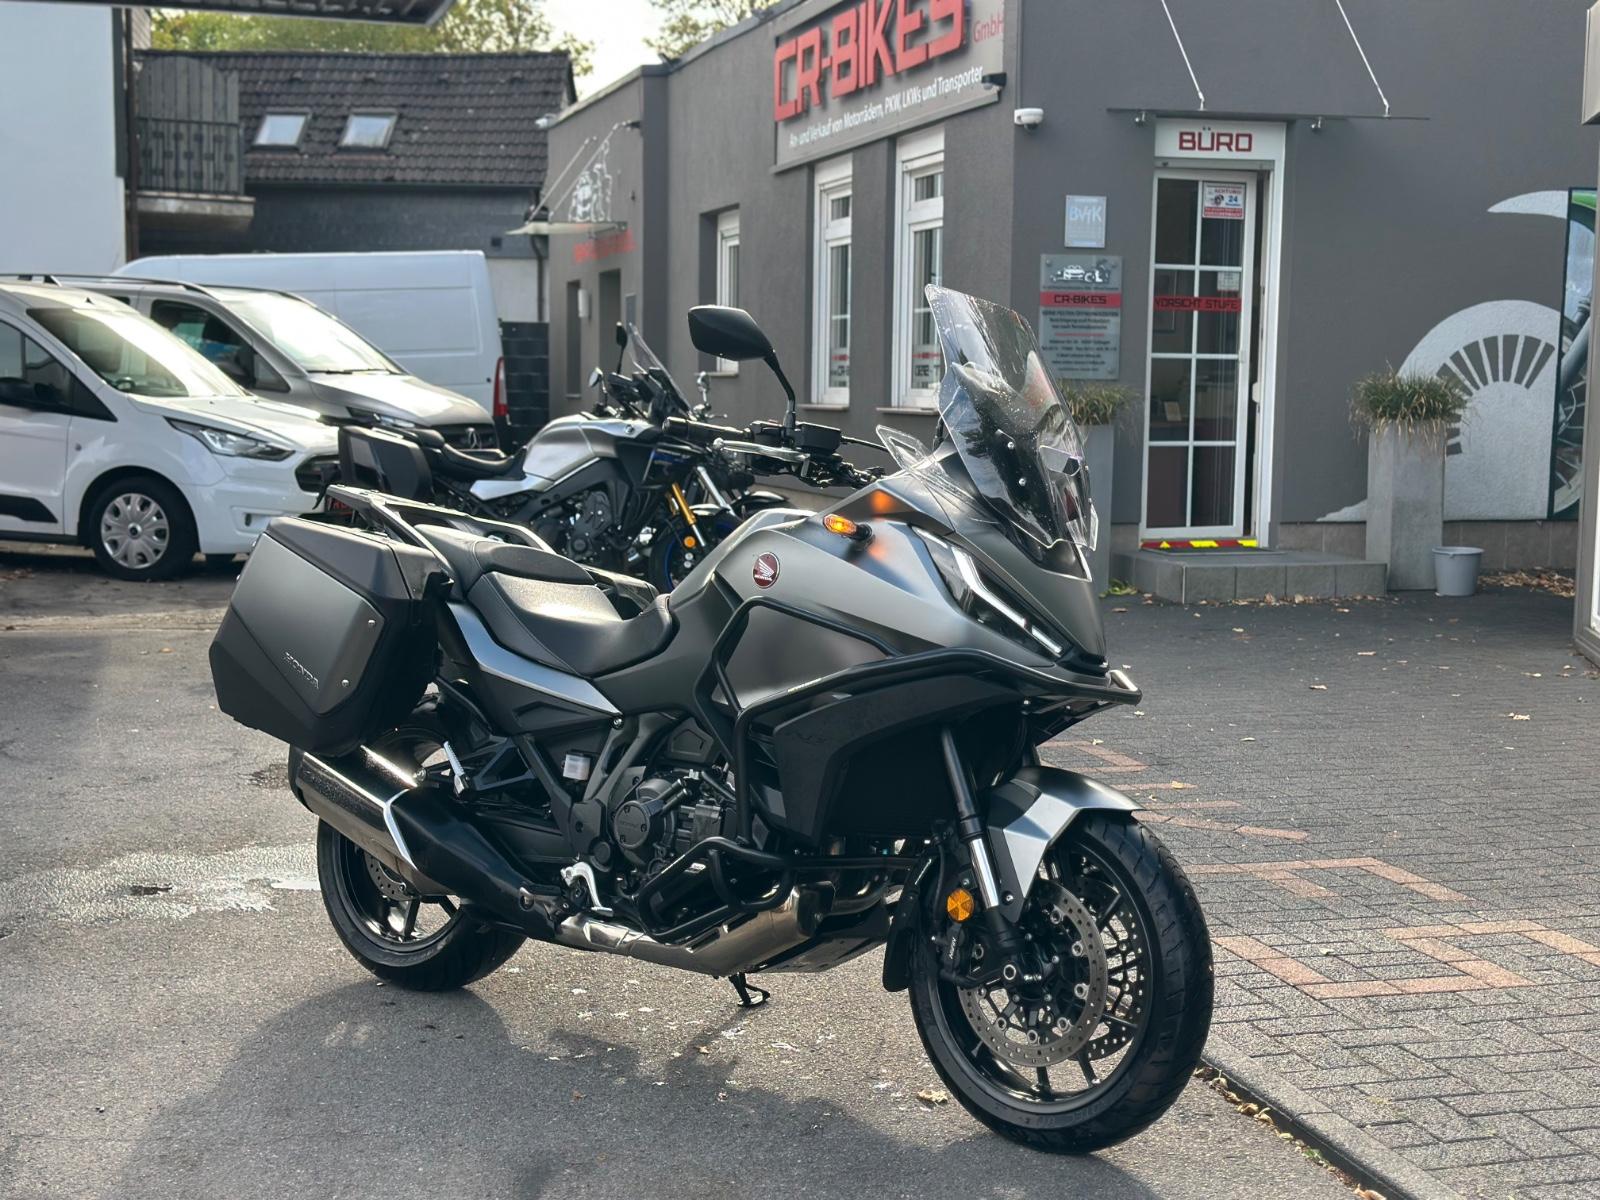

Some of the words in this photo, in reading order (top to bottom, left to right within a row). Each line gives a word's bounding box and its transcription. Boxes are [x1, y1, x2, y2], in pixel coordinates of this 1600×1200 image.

[774, 0, 966, 121] CR-BIKES
[811, 118, 833, 141] Verkauf
[902, 86, 921, 108] LKWs
[922, 78, 937, 101] und
[937, 66, 983, 96] Transporter
[1178, 126, 1253, 152] BÜRO
[1054, 294, 1107, 305] CR-BIKES
[1154, 297, 1200, 308] VORSICHT
[1206, 299, 1238, 310] STUFE
